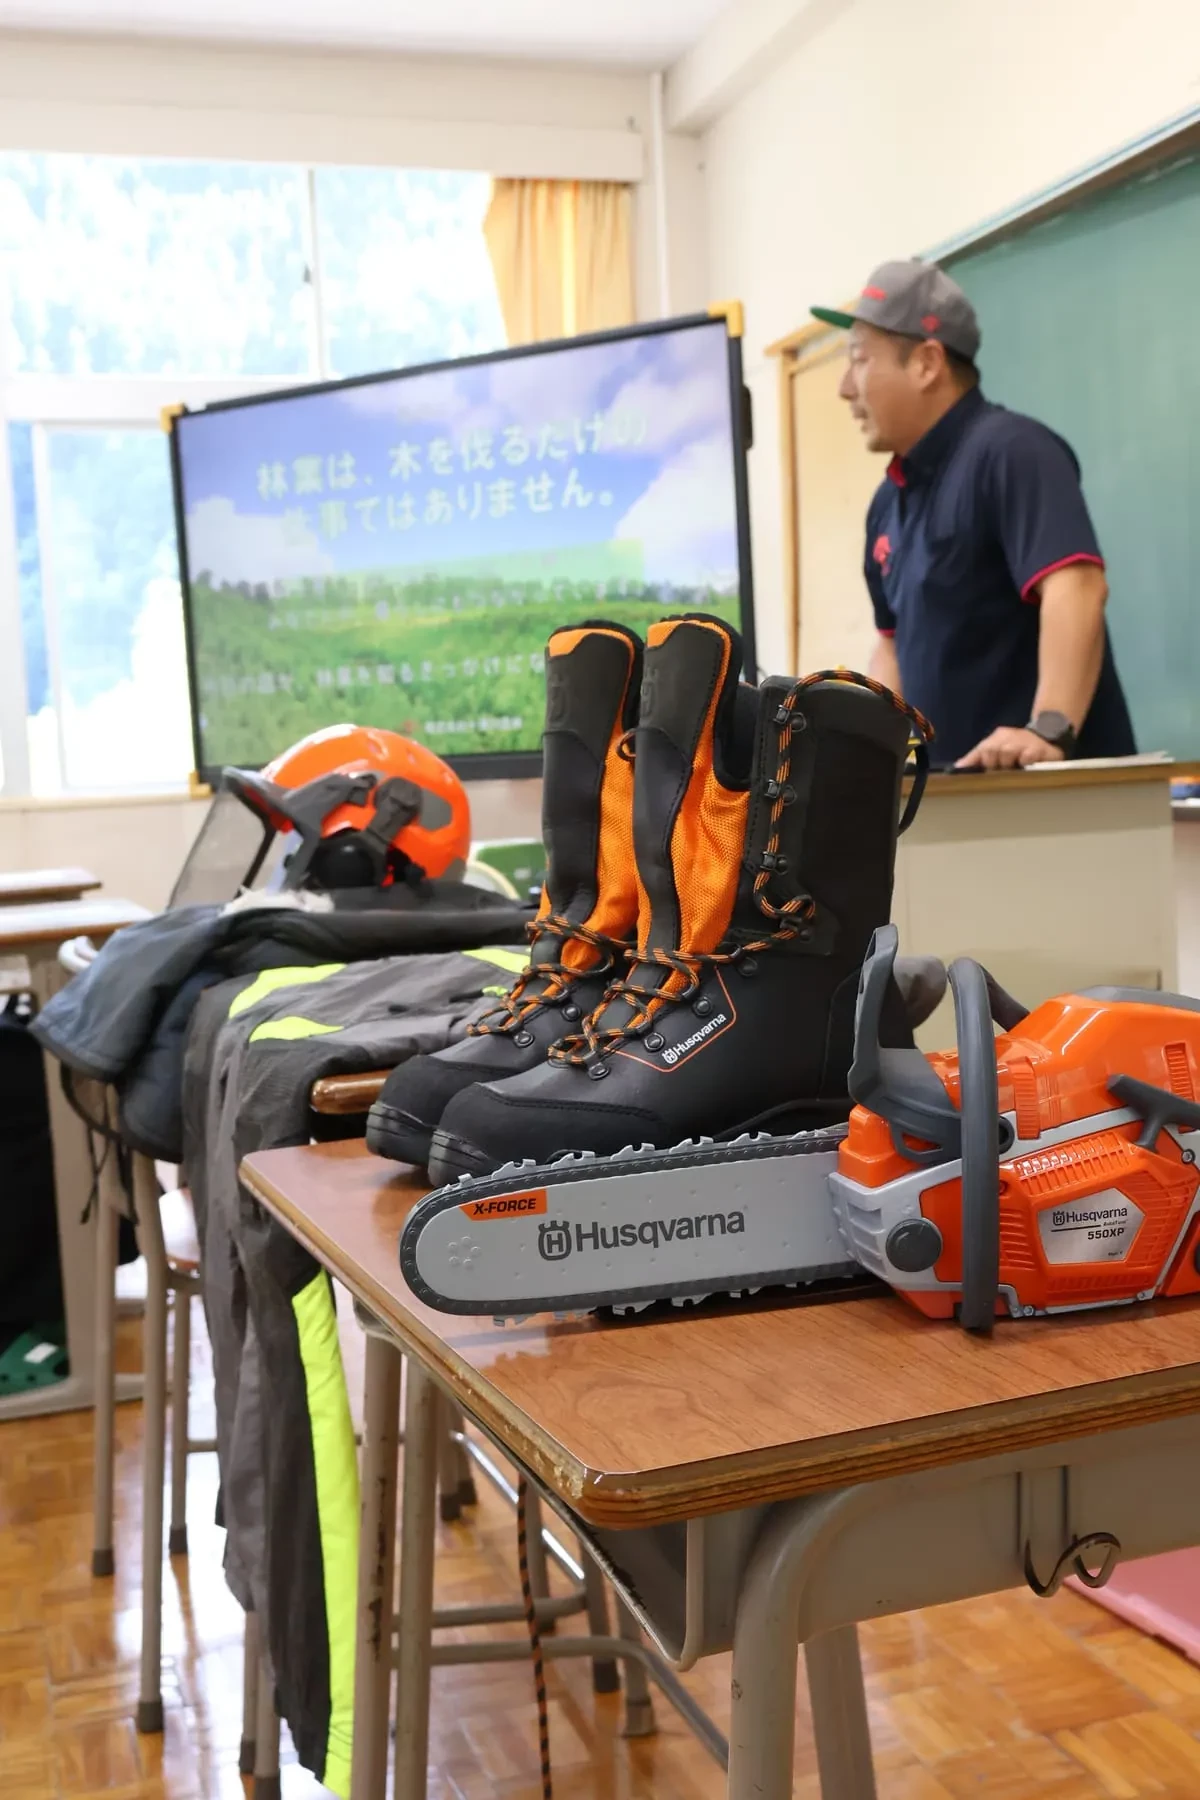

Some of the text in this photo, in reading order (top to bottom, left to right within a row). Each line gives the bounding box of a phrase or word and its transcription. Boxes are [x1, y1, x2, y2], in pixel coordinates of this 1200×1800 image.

[673, 1013, 727, 1056] Husqvarna
[473, 1198, 536, 1215] X-FORCE
[1066, 1207, 1127, 1222] Husqvarna
[575, 1210, 745, 1252] Husqvarna
[1087, 1227, 1124, 1240] 550XP
